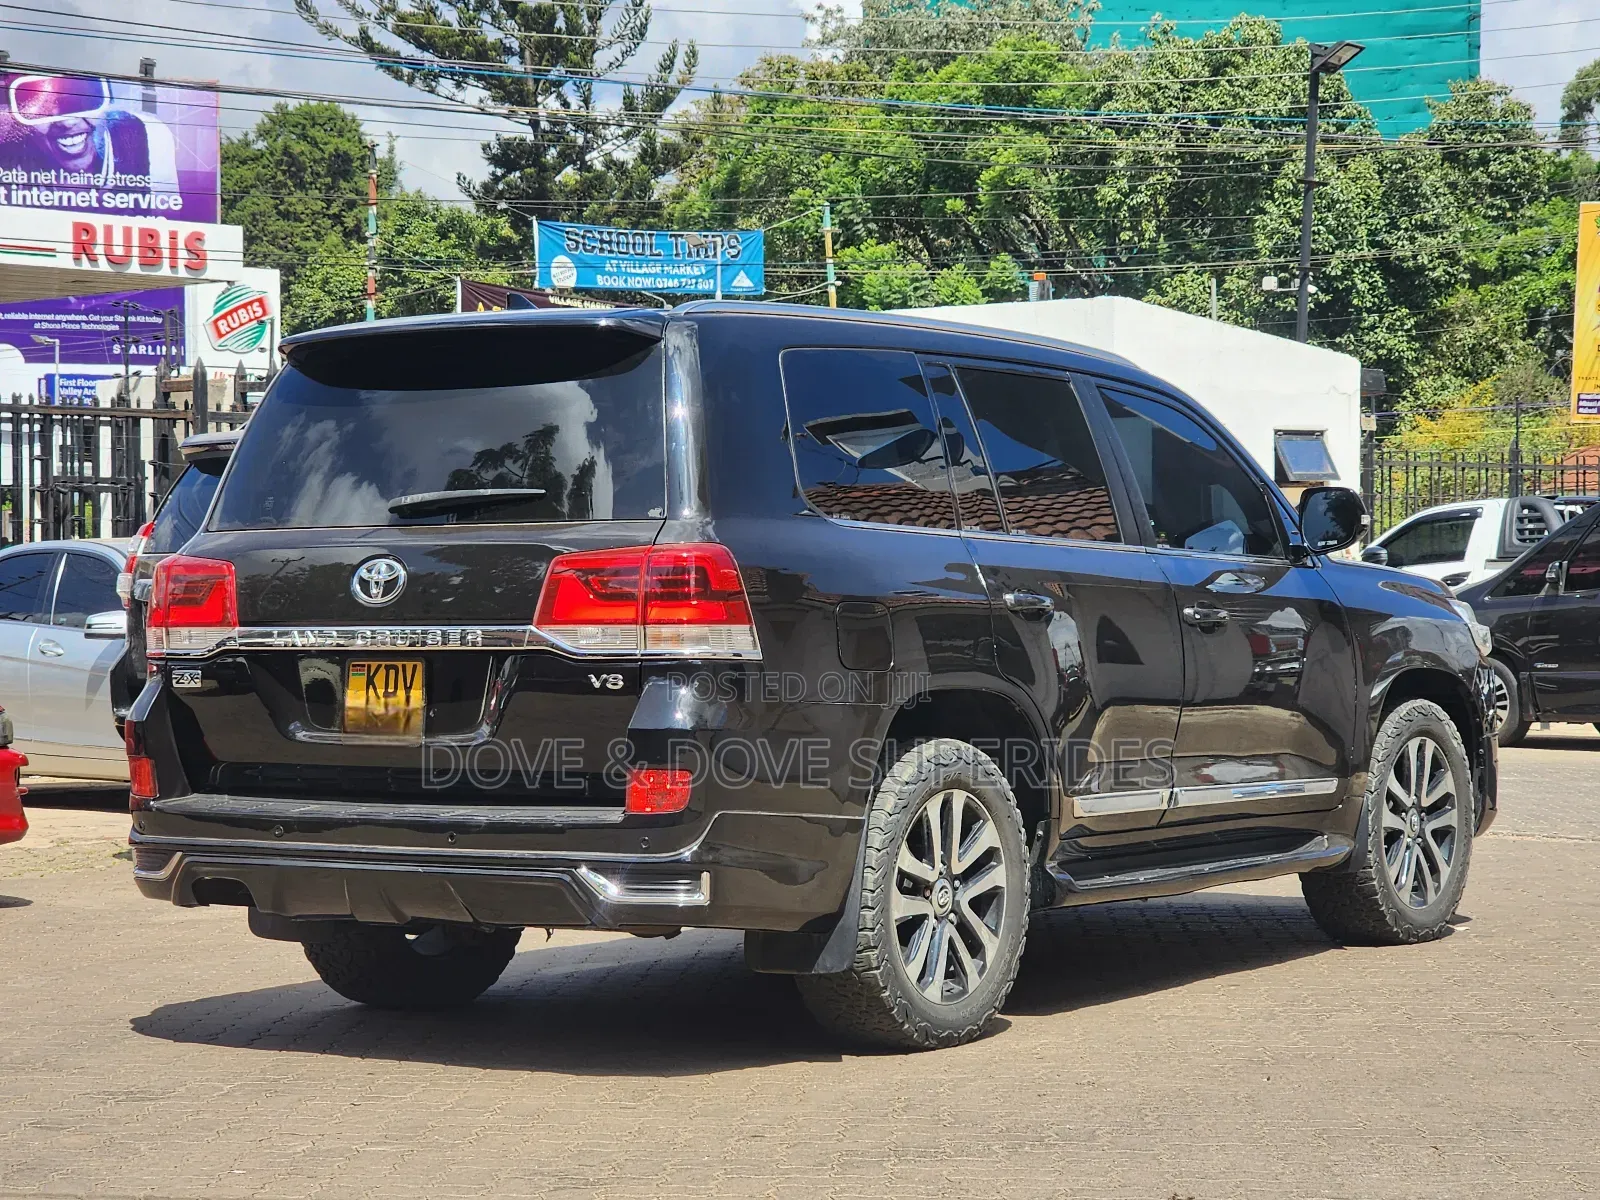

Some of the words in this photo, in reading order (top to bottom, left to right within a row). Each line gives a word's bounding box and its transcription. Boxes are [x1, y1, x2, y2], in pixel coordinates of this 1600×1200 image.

[31, 168, 57, 184] net
[60, 168, 104, 186] haina
[107, 171, 153, 187] stress
[11, 185, 99, 207] internet
[102, 191, 183, 210] service
[565, 228, 663, 258] SCHOOL
[605, 260, 618, 272] AT
[619, 261, 661, 274] VILLAGE
[664, 263, 706, 275] MARKET
[596, 275, 626, 287] BOOK
[549, 295, 583, 308] VILLAGE
[81, 322, 119, 331] Technologies
[60, 378, 76, 387] First
[77, 378, 97, 387] Floor
[60, 387, 82, 397] Valley
[267, 630, 337, 647] LAND
[356, 629, 483, 647] CRUISER
[366, 663, 418, 701] KDV
[588, 674, 624, 690] V8
